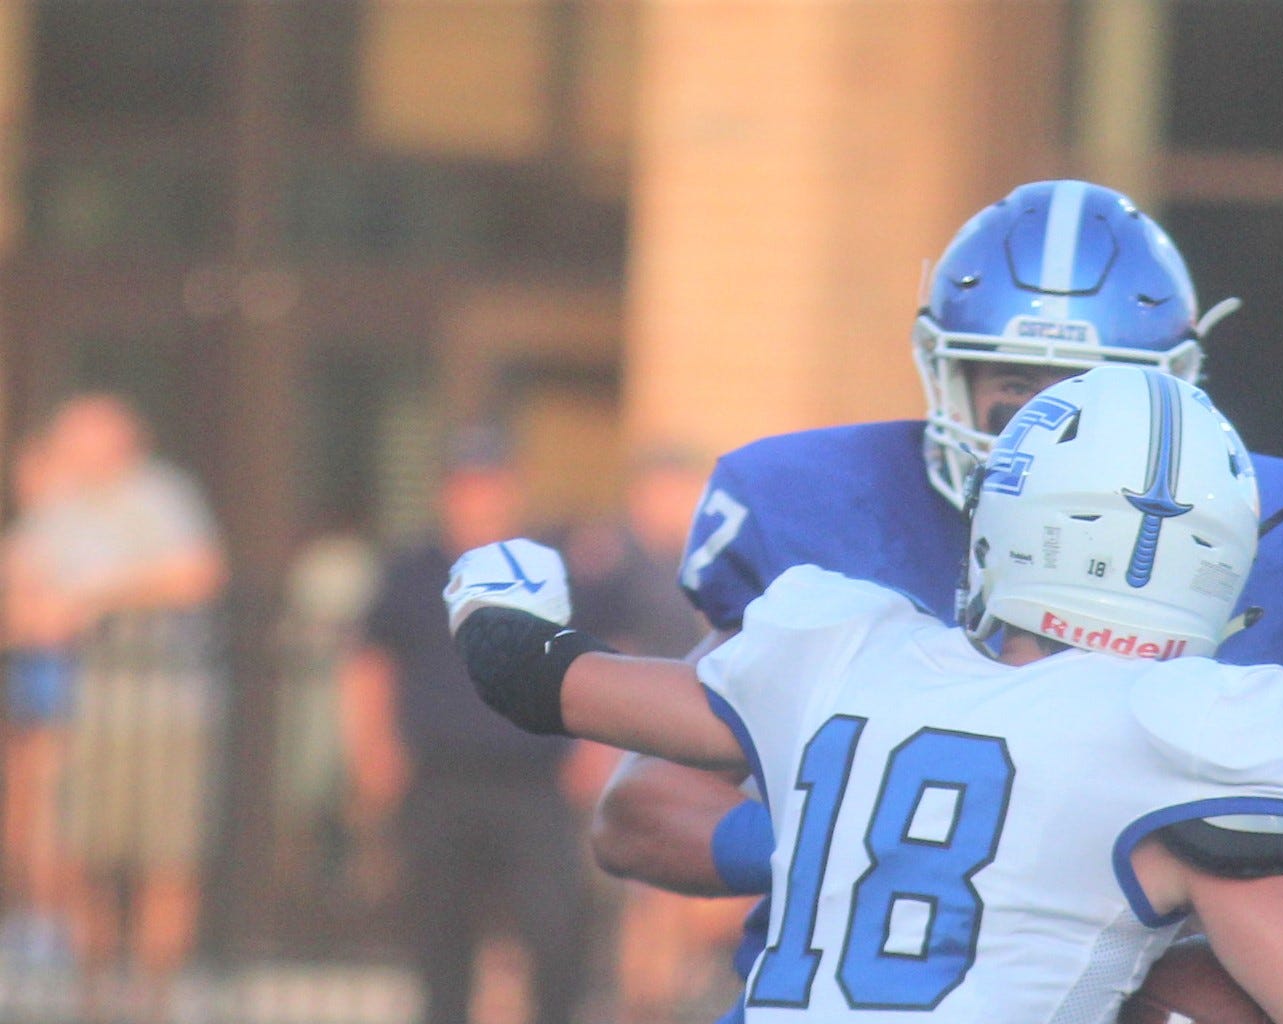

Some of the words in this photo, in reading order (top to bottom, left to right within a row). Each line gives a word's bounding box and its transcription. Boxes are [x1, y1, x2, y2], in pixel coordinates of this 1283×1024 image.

[1087, 558, 1106, 578] 18
[1040, 611, 1188, 662] Riddell
[746, 713, 1016, 1011] 18
